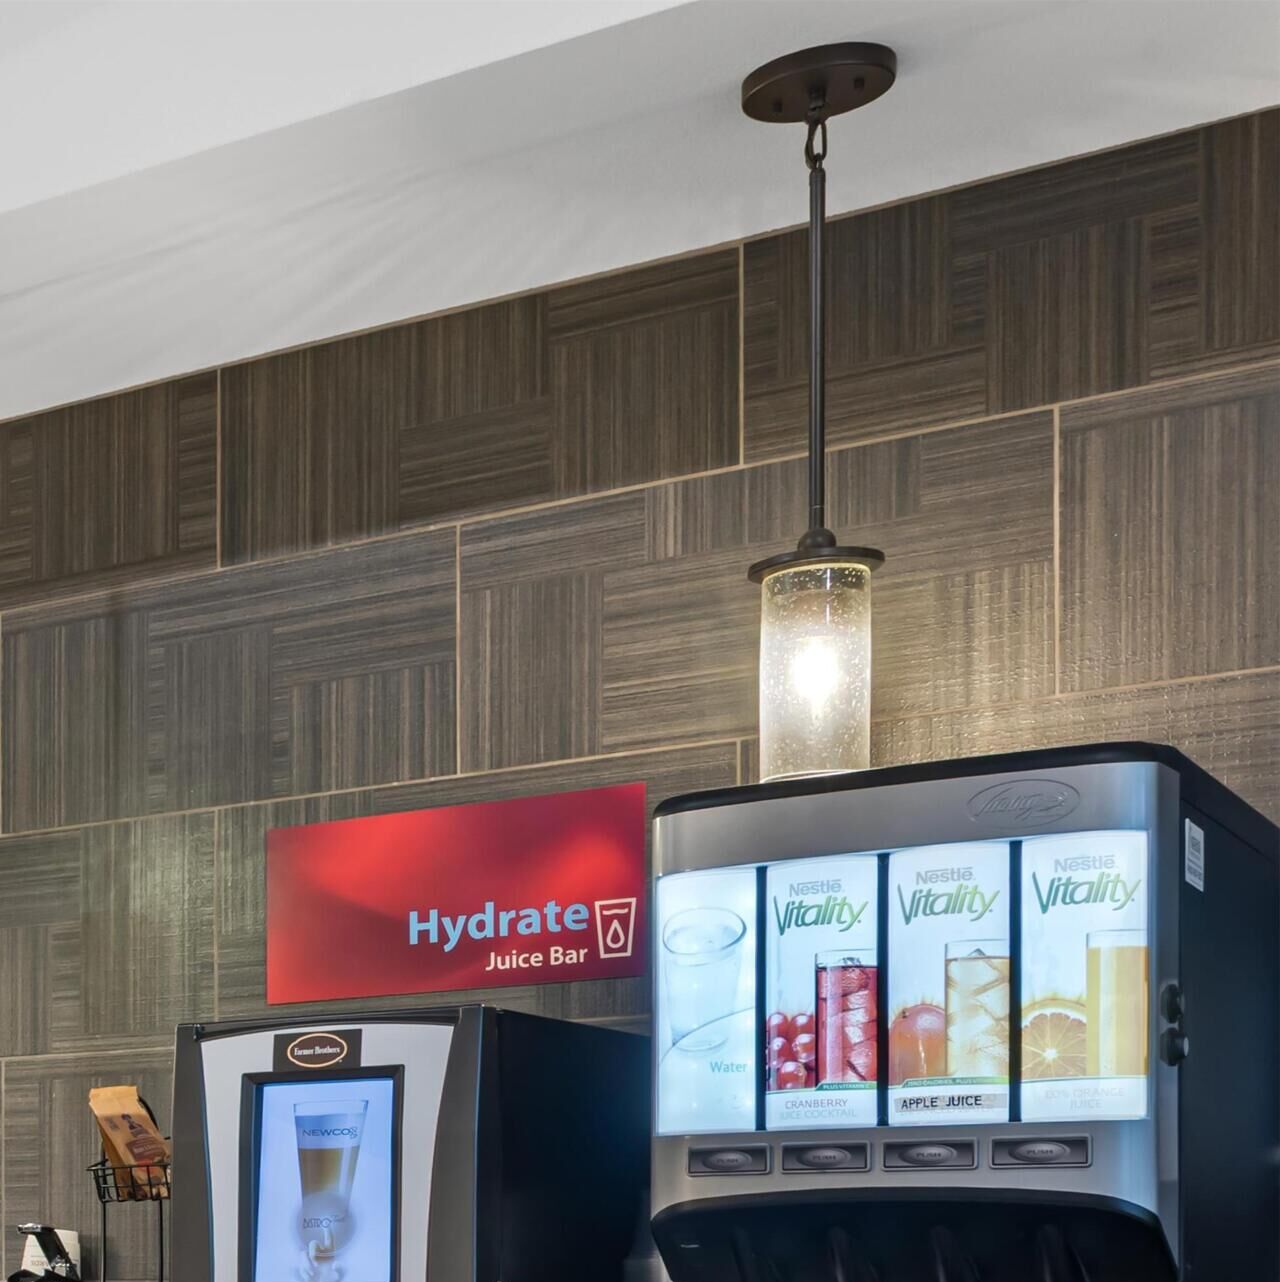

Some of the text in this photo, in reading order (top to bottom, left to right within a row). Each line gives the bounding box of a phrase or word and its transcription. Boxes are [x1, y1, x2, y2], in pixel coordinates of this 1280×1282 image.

[408, 900, 590, 953] Hydrate
[485, 945, 589, 972] Juice Bar
[710, 1060, 748, 1073] Water
[785, 1099, 848, 1110] CRANBERRY
[901, 1096, 939, 1110] APPLE
[946, 1095, 983, 1107] JUICE
[302, 1127, 351, 1137] NEWCO
